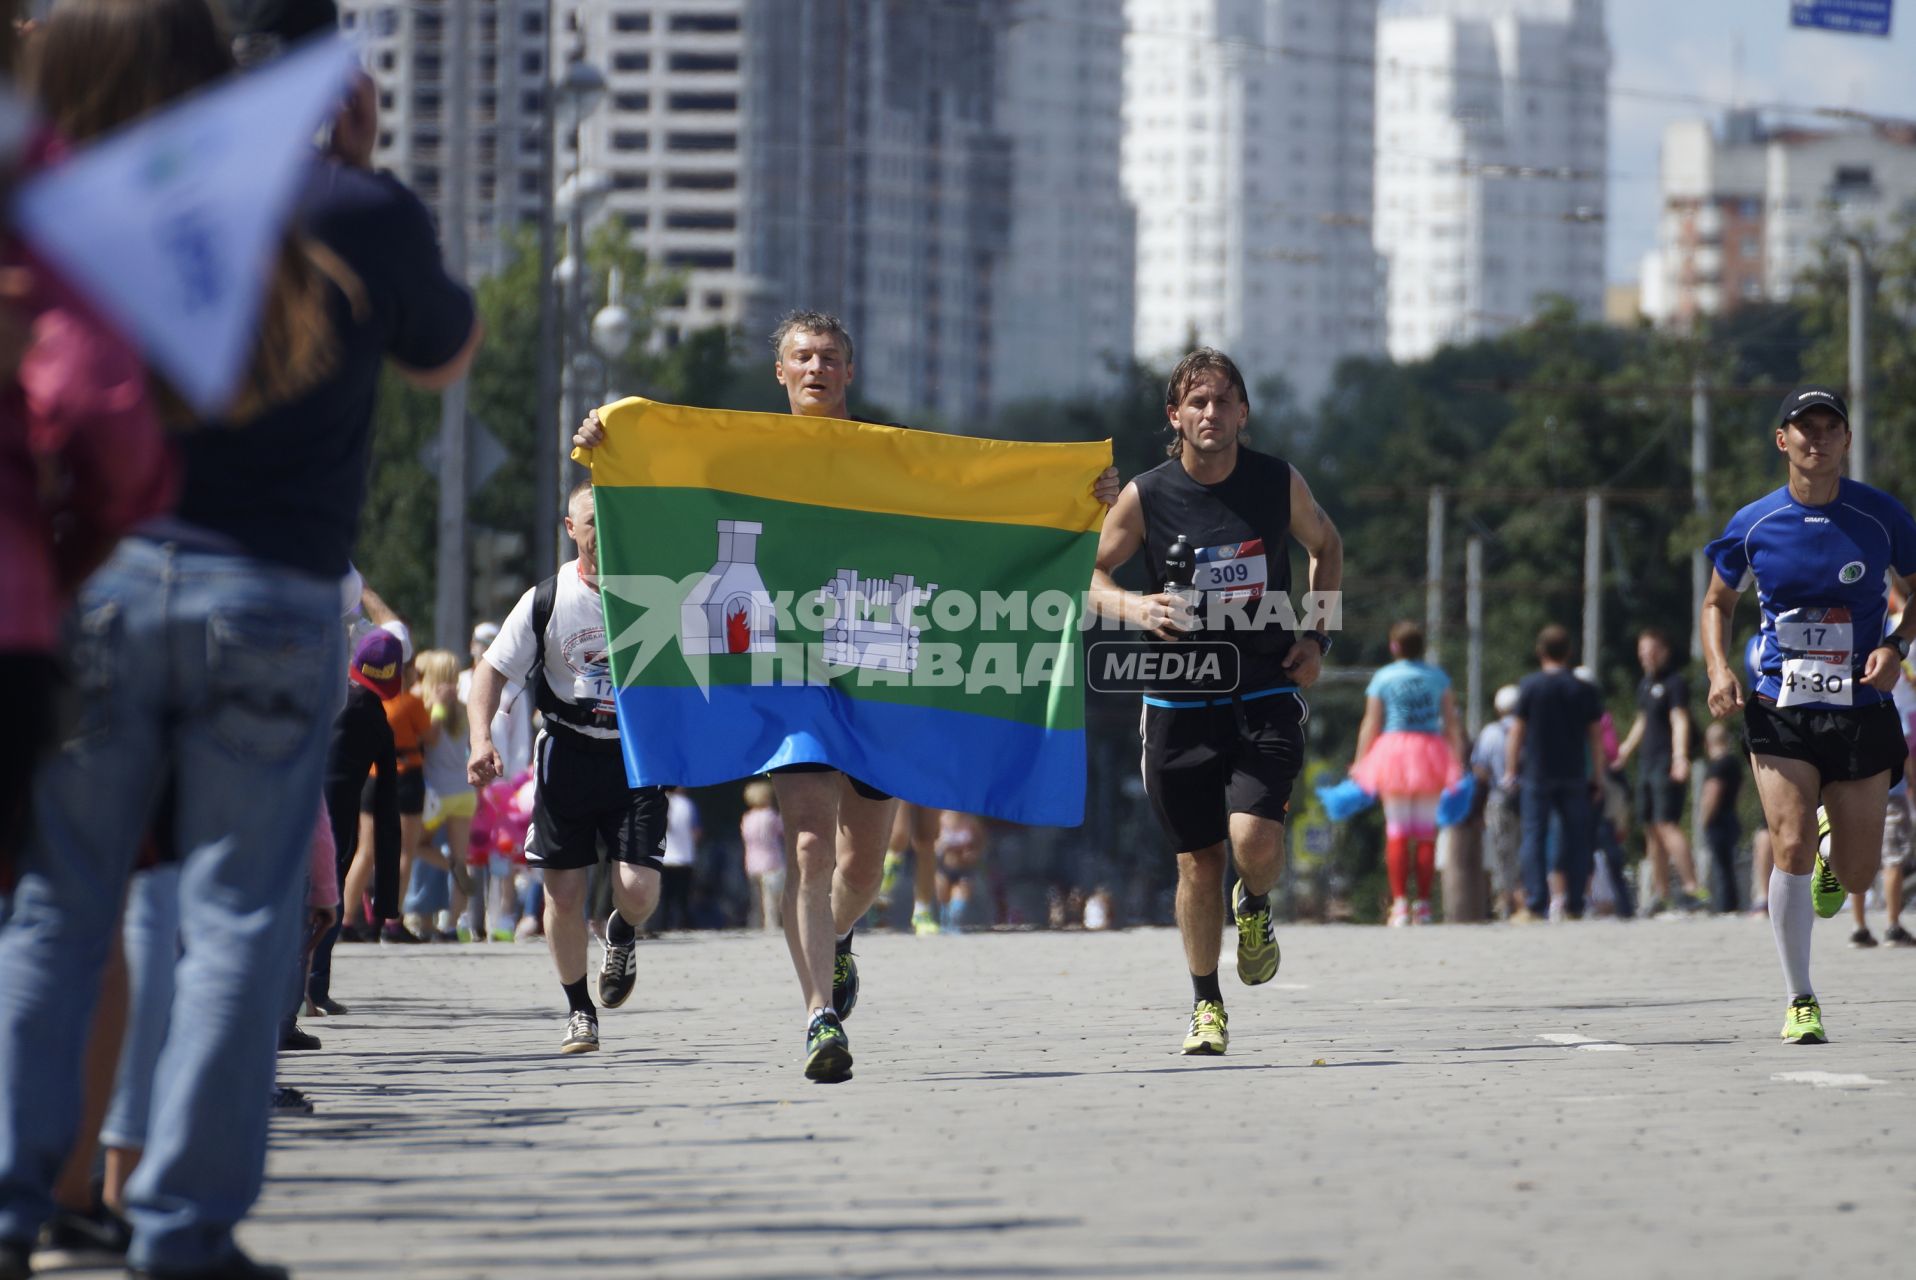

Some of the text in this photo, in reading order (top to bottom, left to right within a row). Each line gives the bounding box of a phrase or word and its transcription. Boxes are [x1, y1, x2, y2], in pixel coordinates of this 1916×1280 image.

[1209, 563, 1249, 585] 309
[1802, 628, 1827, 646] 17
[1786, 671, 1843, 694] 4:30
